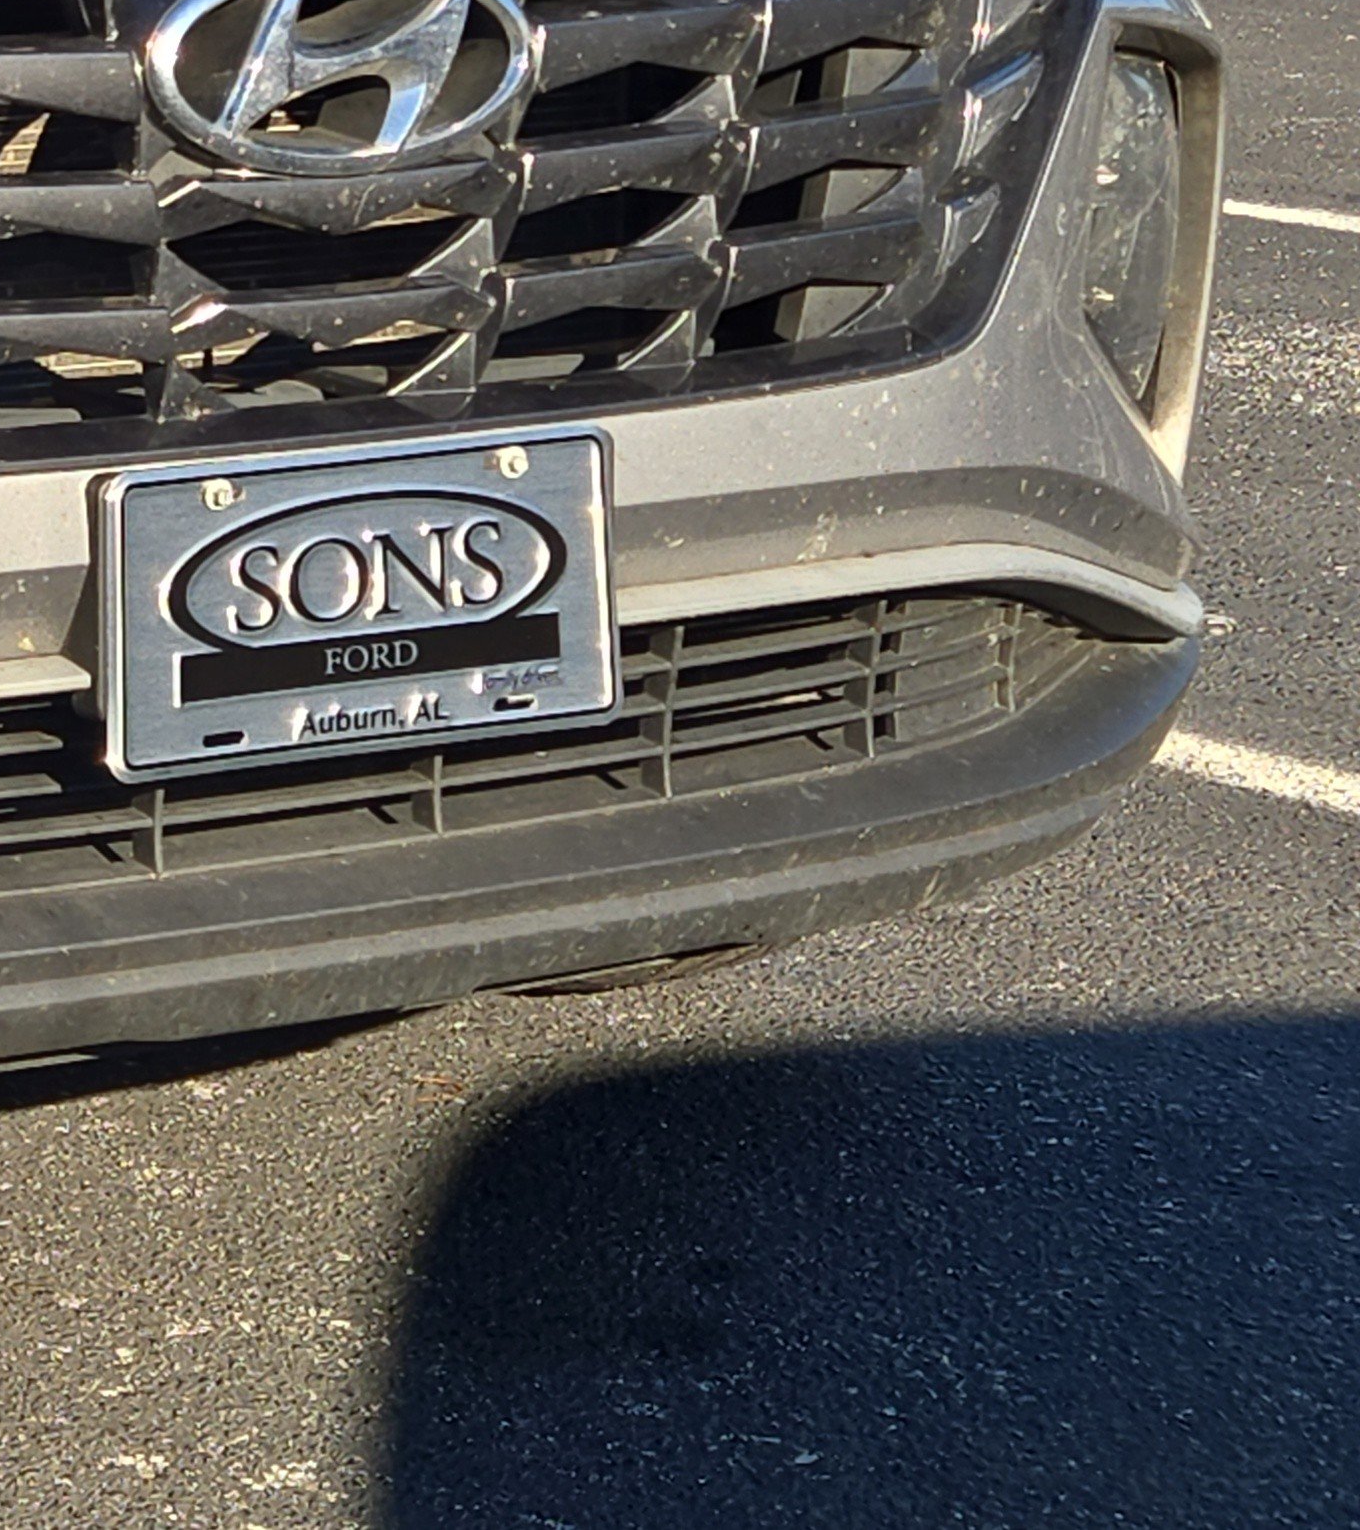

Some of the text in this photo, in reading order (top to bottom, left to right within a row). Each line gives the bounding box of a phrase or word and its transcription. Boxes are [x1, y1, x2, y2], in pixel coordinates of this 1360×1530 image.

[229, 518, 504, 633] SONS
[324, 639, 419, 676] FORD
[297, 698, 450, 737] Auburn, AL
